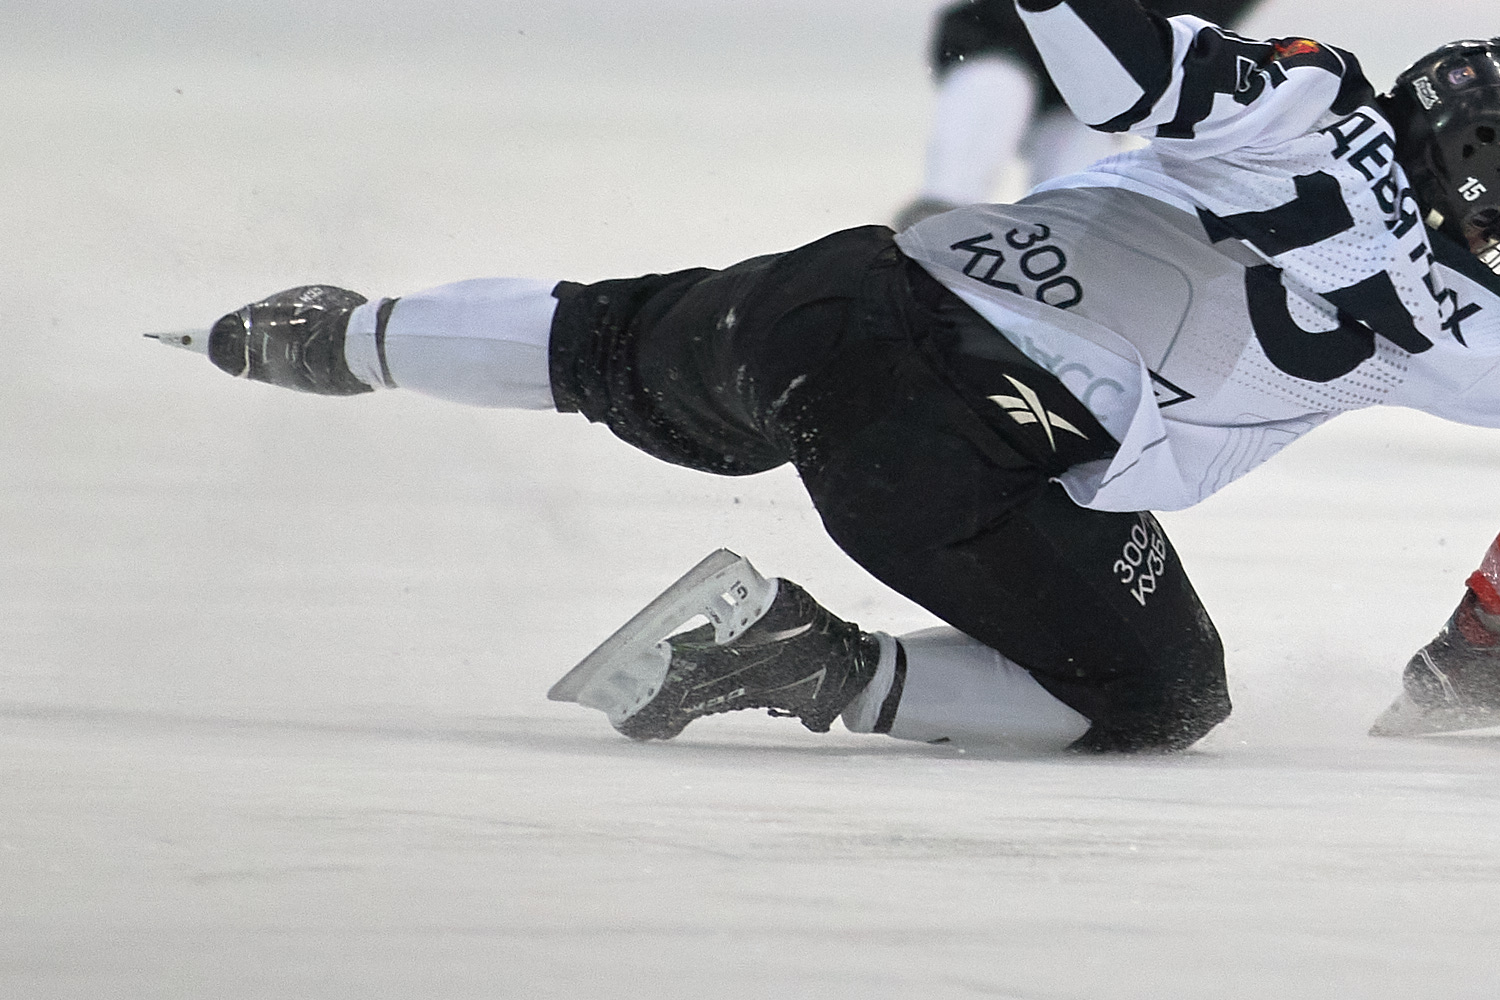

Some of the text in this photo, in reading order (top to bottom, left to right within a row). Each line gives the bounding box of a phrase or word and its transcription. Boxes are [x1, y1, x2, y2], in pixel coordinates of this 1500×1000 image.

[1458, 176, 1487, 201] 15
[1005, 223, 1083, 310] 300
[1113, 523, 1148, 584] 300
